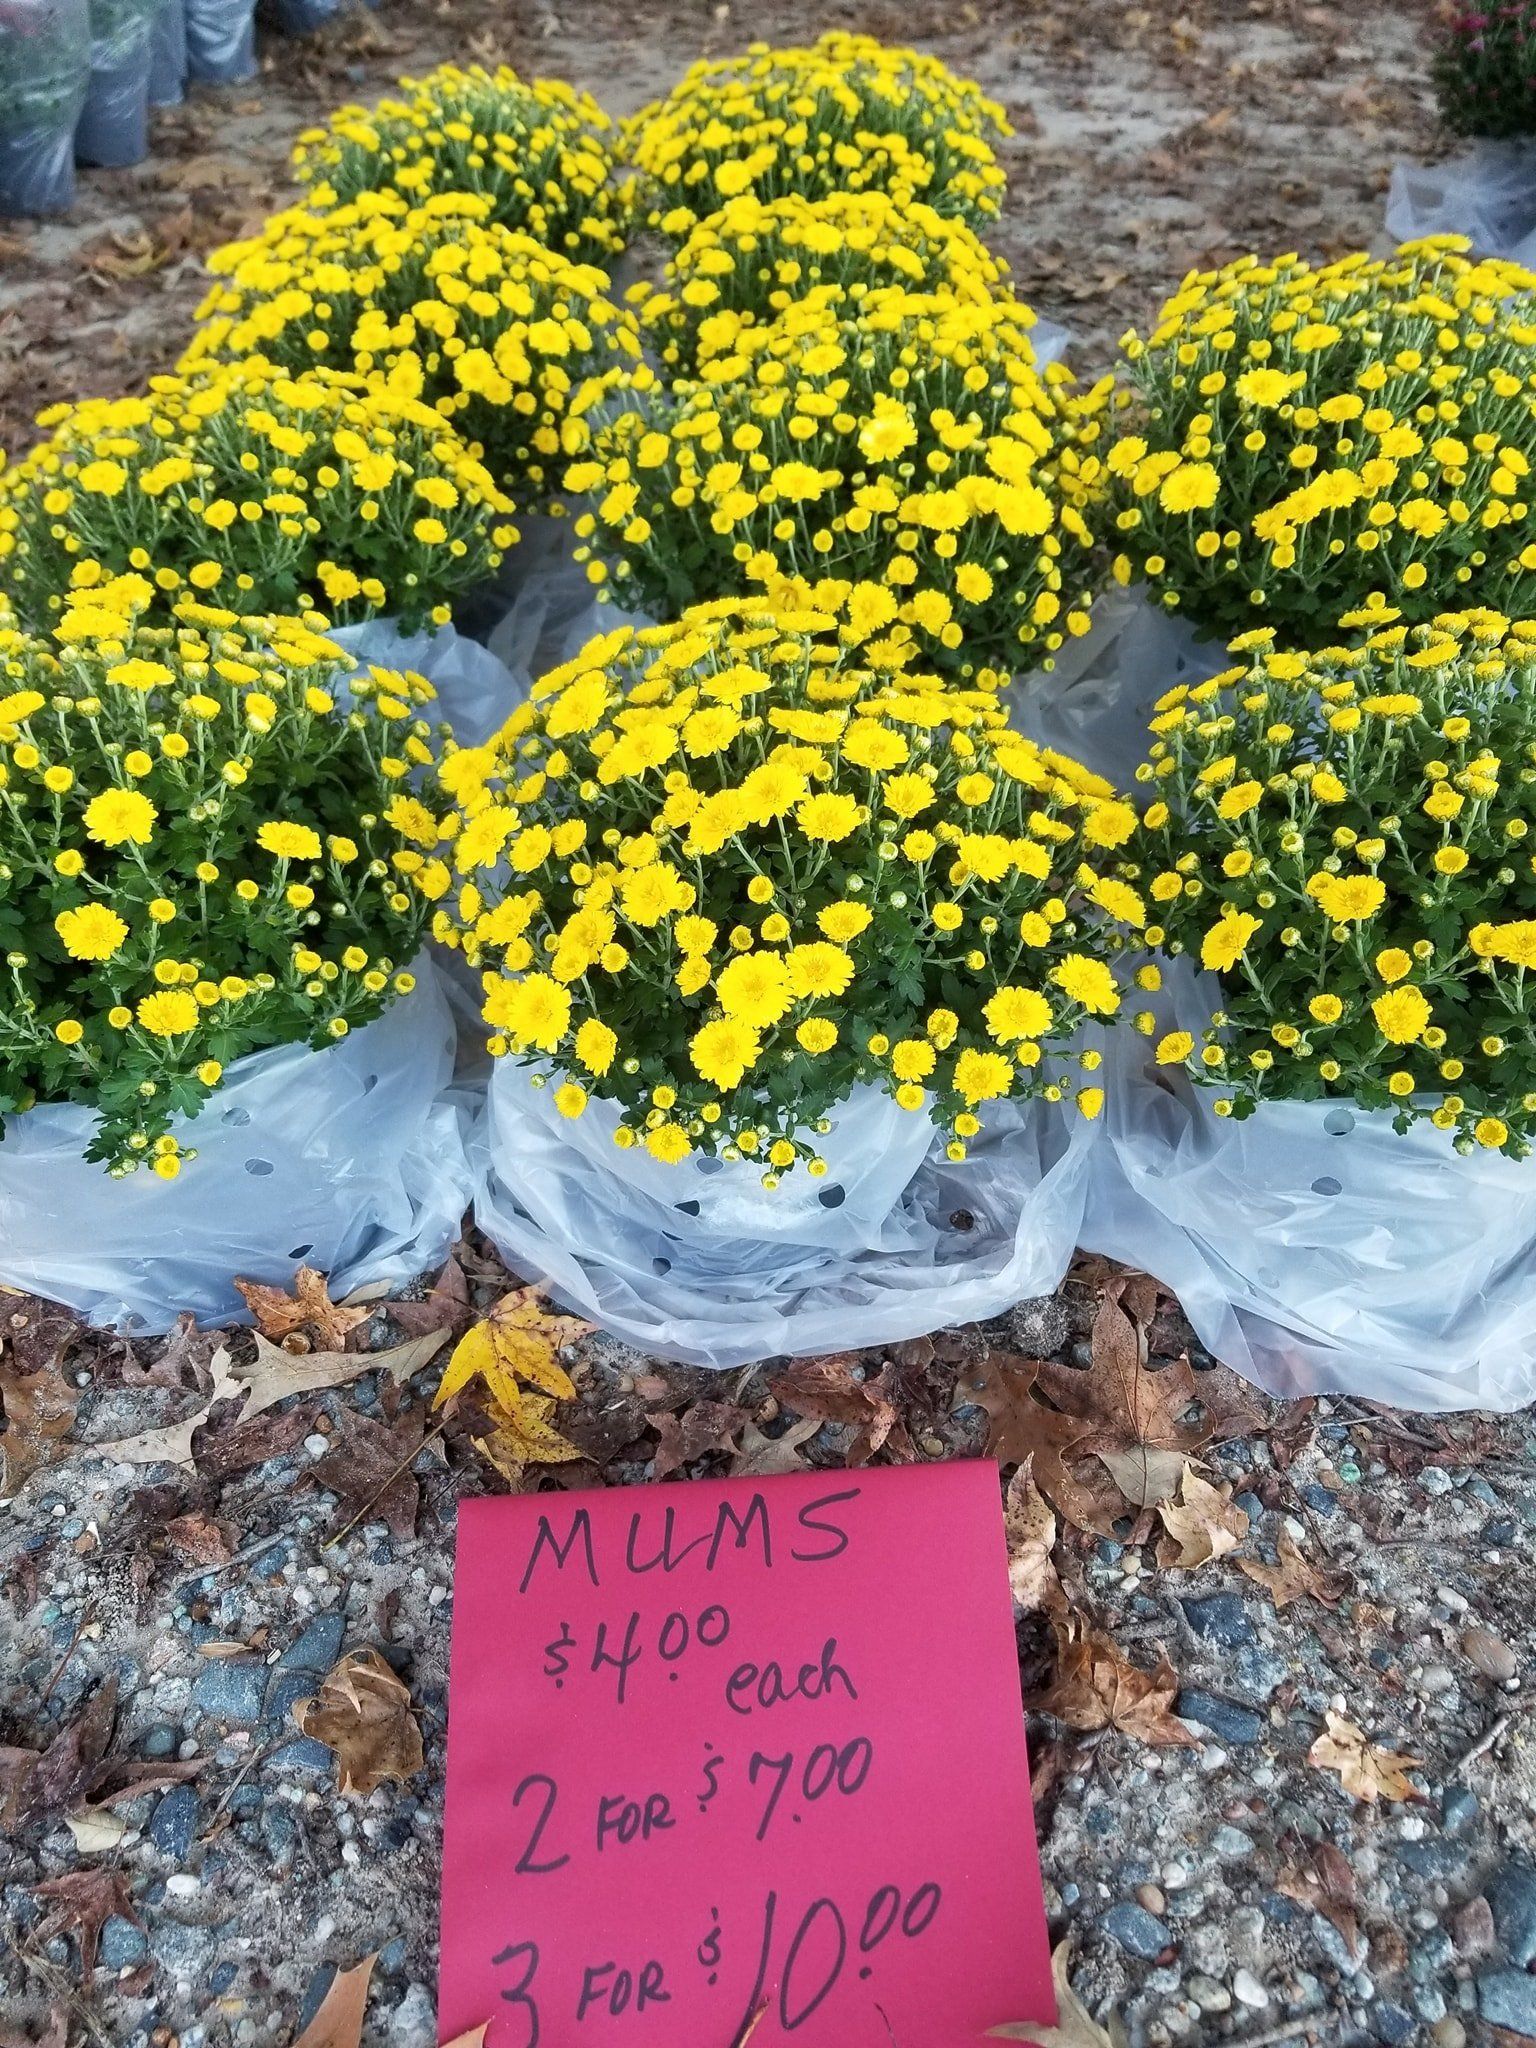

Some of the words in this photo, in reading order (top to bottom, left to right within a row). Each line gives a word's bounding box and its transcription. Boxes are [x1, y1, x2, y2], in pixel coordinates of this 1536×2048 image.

[519, 1488, 860, 1593] MUMS
[543, 1605, 730, 1703] $4.00
[725, 1638, 857, 1714] each
[512, 1773, 569, 1875] 2
[596, 1793, 676, 1851] FOR
[697, 1738, 873, 1840] $7.00
[491, 1942, 540, 2048] 3
[576, 1960, 671, 2020] FOR
[697, 1883, 942, 2048] $10.00
